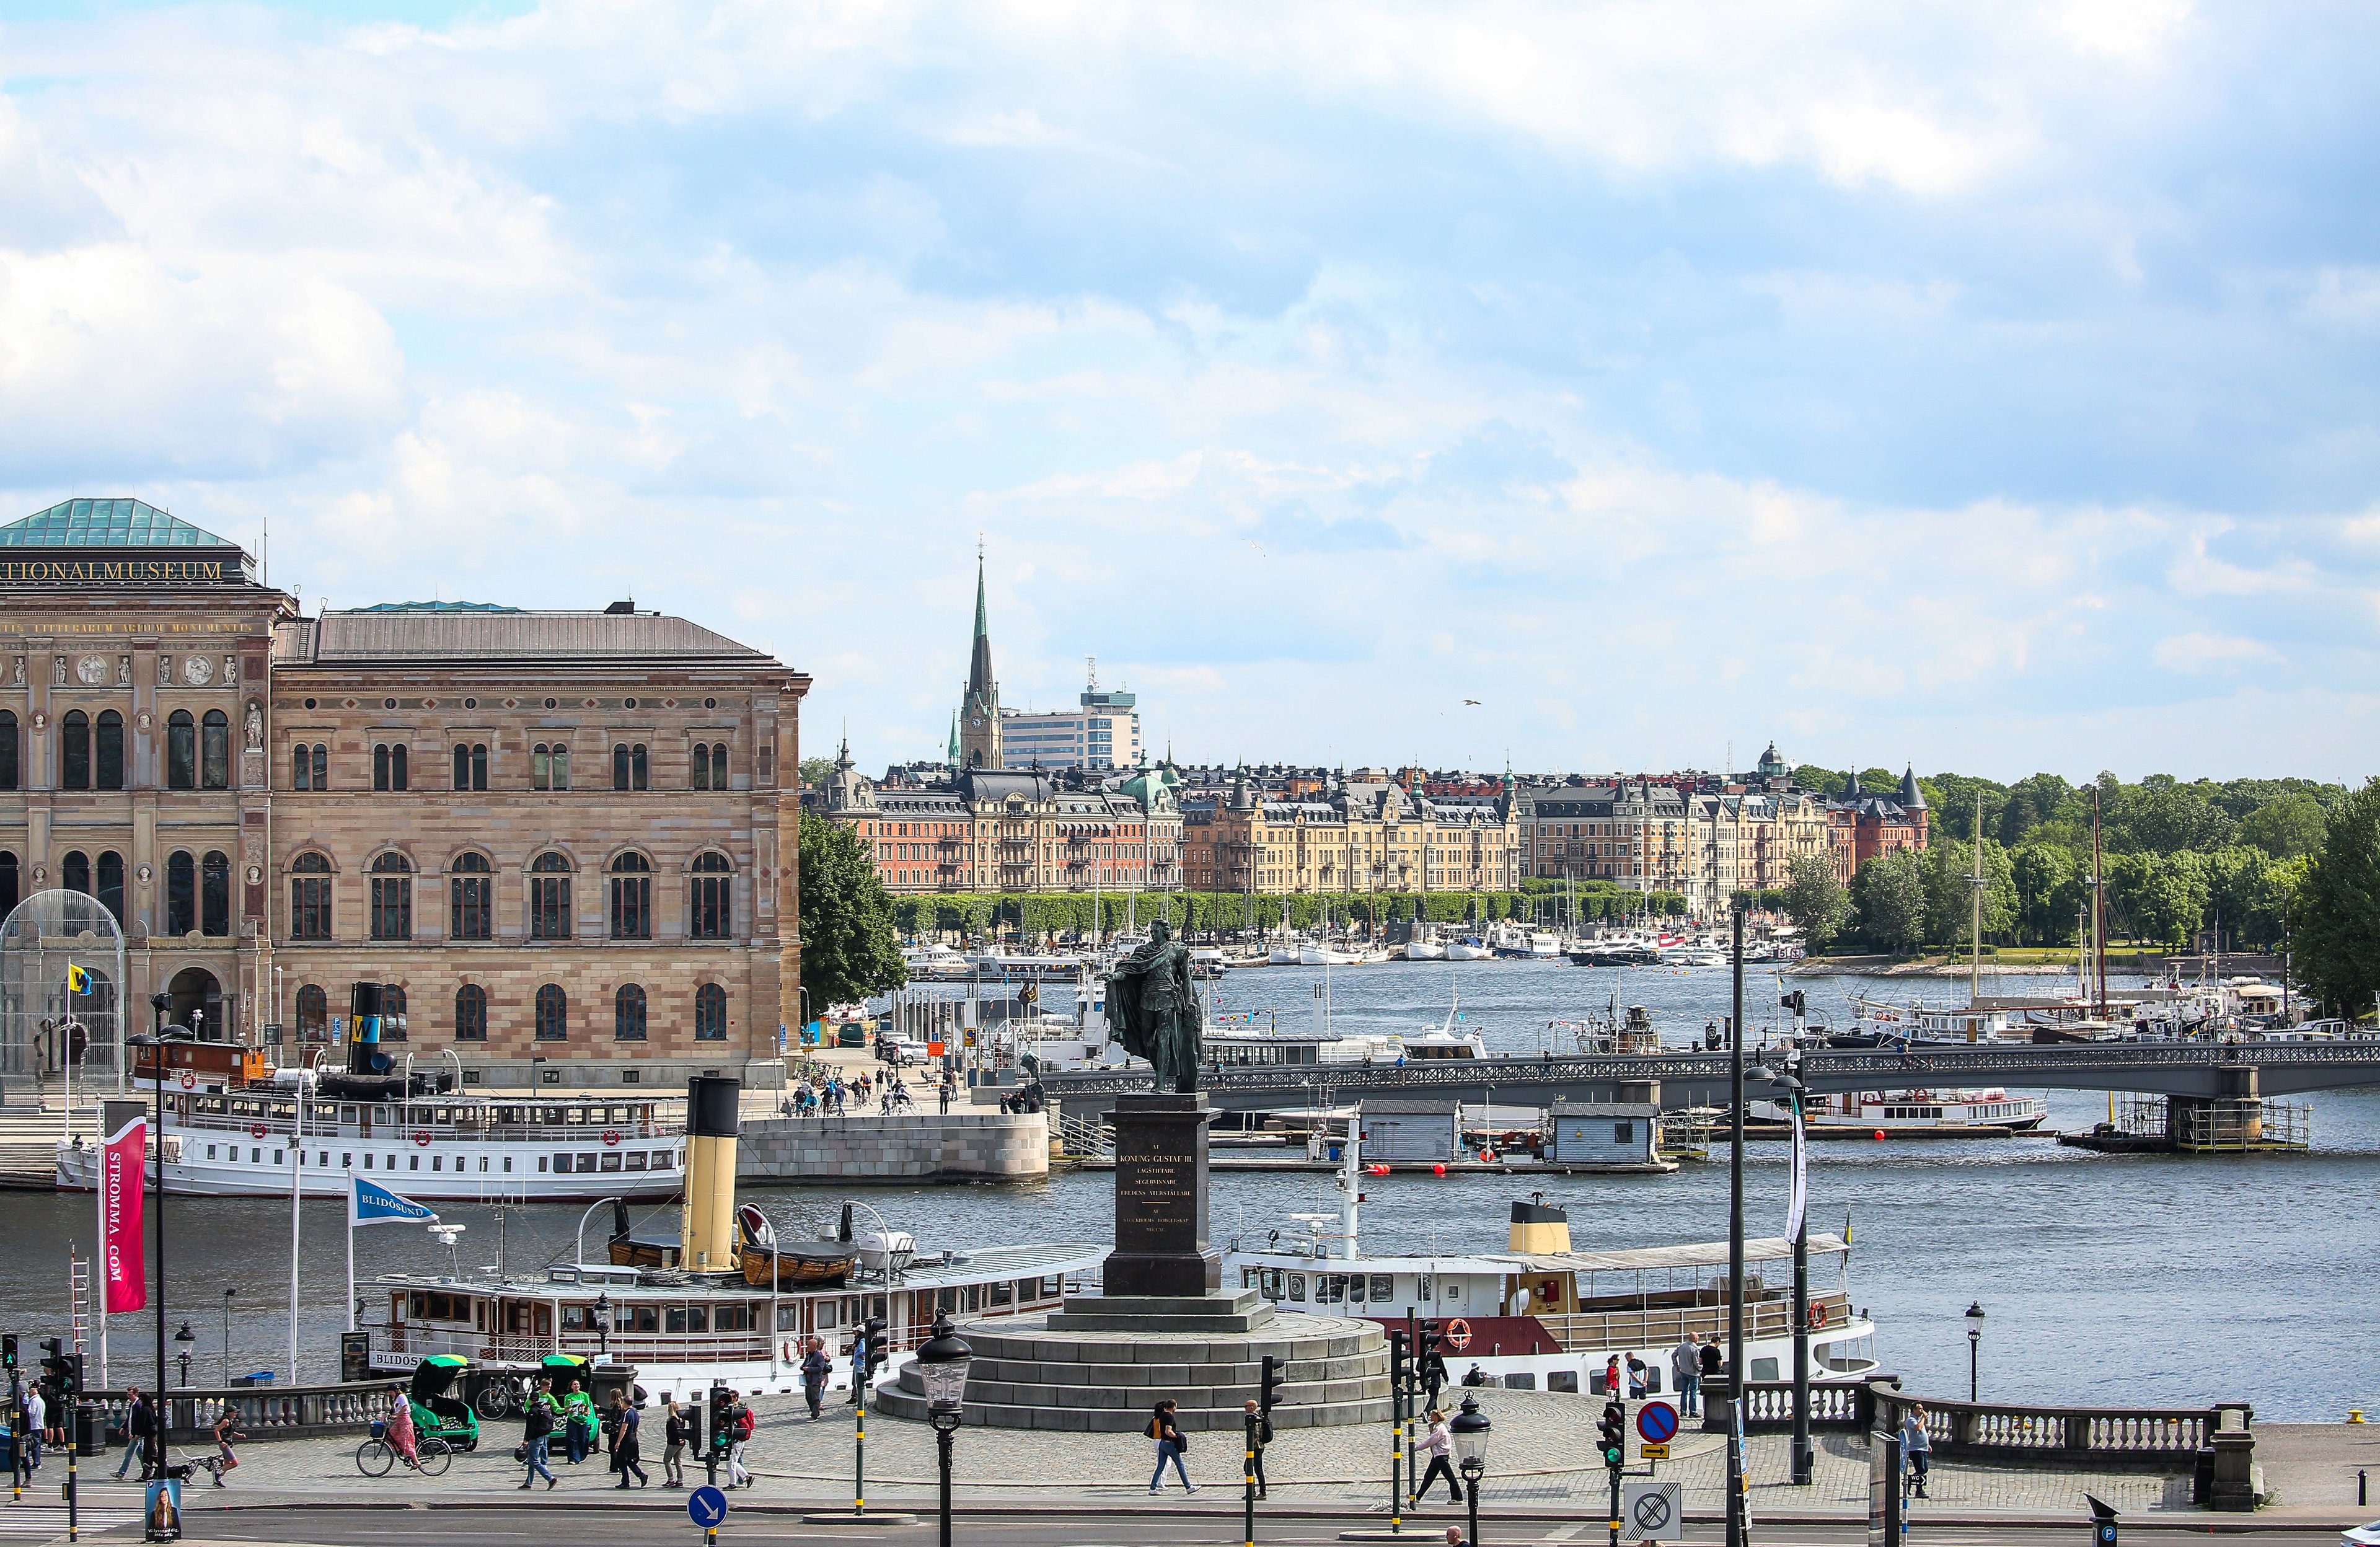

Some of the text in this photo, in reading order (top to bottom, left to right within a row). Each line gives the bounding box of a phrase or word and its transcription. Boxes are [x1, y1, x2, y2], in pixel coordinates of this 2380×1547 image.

[0, 562, 223, 580] TIONALMUSEUM
[1780, 950, 1786, 958] 5
[355, 1020, 372, 1038] W
[361, 1194, 423, 1216] BLIDÖSUND
[2105, 1528, 2113, 1538] P
